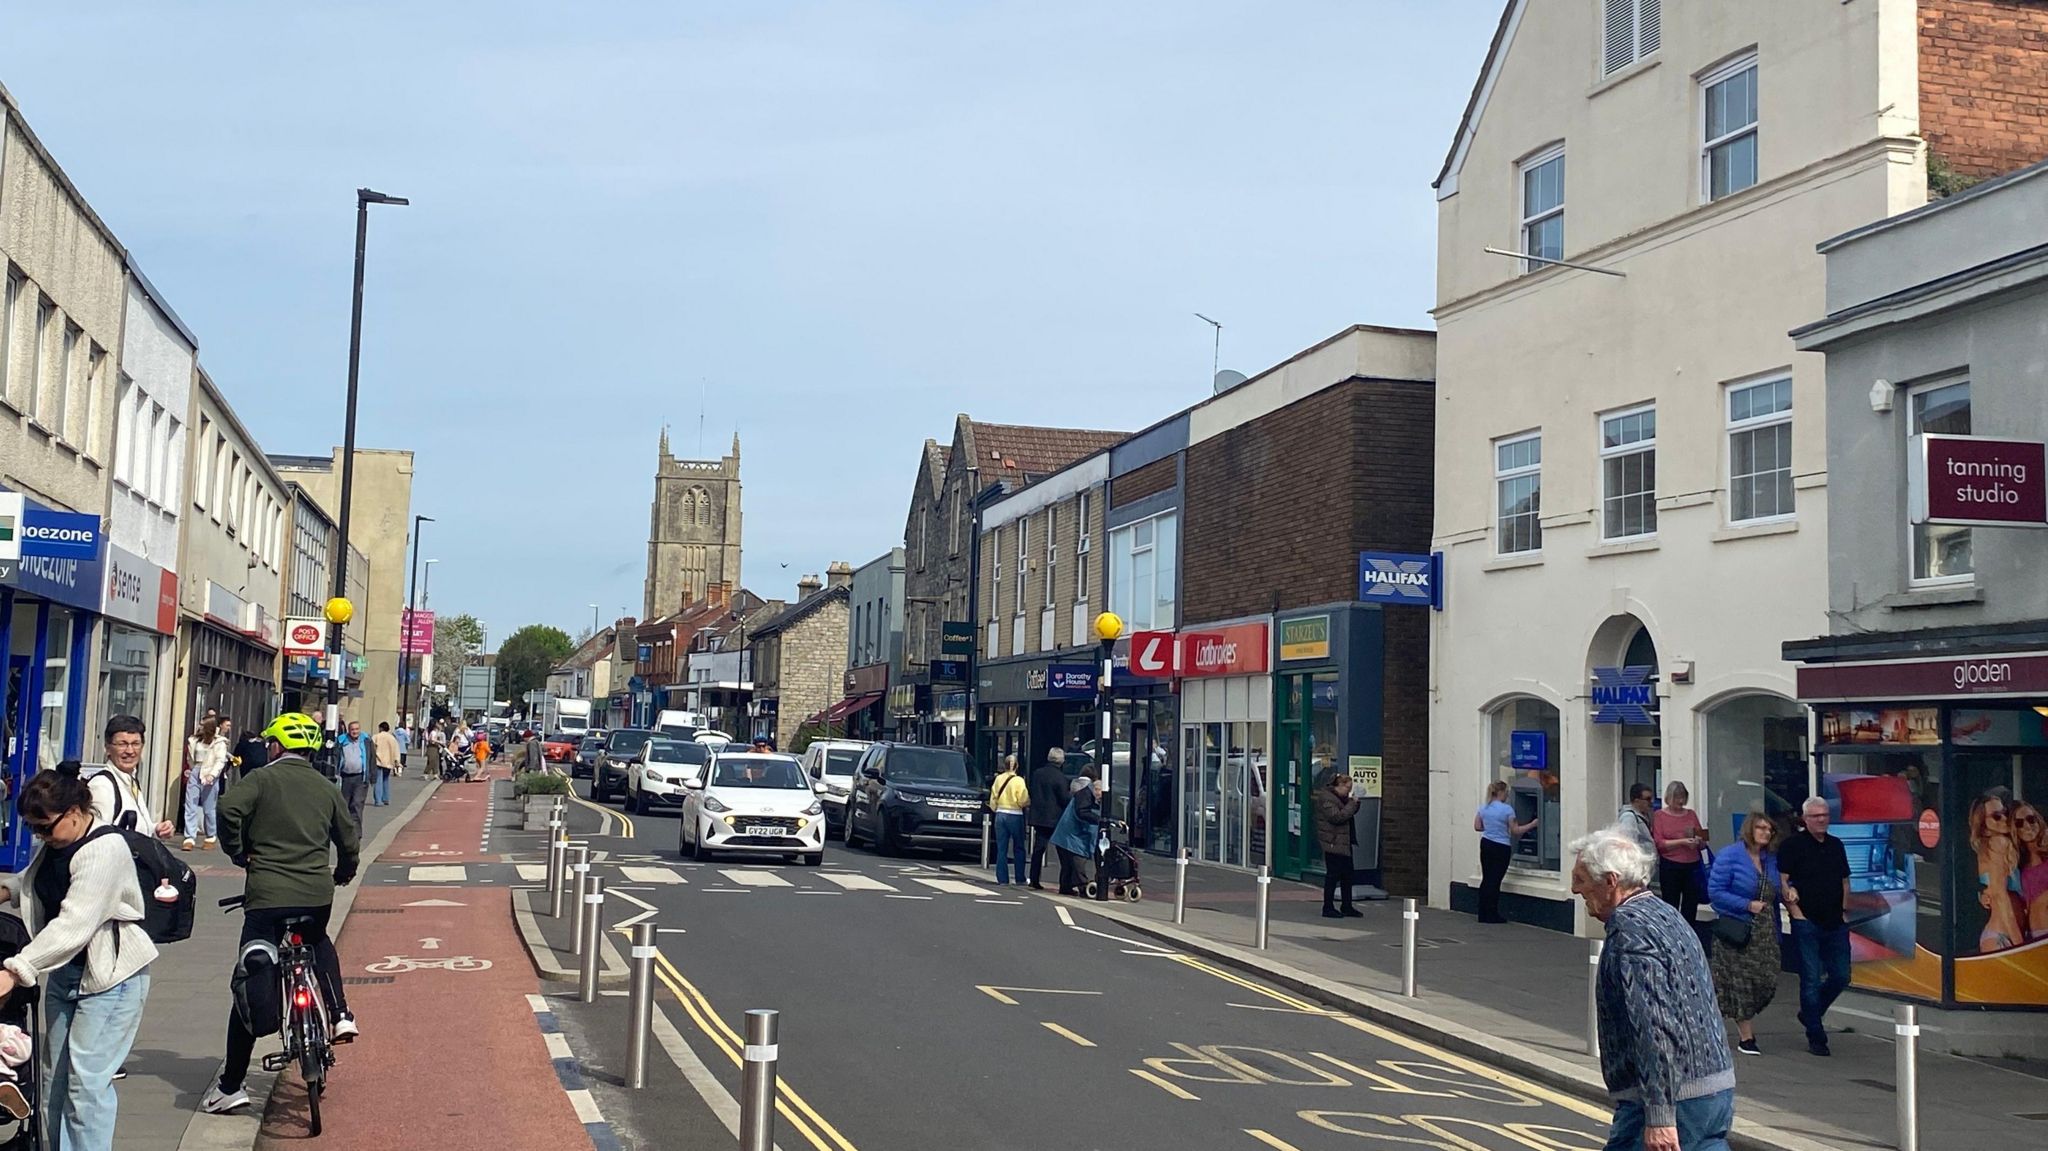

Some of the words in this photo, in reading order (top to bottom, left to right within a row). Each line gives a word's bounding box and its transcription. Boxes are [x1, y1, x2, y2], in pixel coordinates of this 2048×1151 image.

[1946, 457, 2026, 484] tanning
[1956, 482, 2019, 504] studio
[22, 525, 93, 543] oezone
[117, 569, 141, 604] sense
[1364, 570, 1429, 586] HALIFAX
[293, 633, 317, 641] OFFICE
[1195, 639, 1238, 668] Ladbrokes
[940, 662, 957, 675] TG
[1065, 672, 1092, 681] Dorothy
[1953, 659, 2011, 689] gloden
[1592, 686, 1652, 705] HALIFAX
